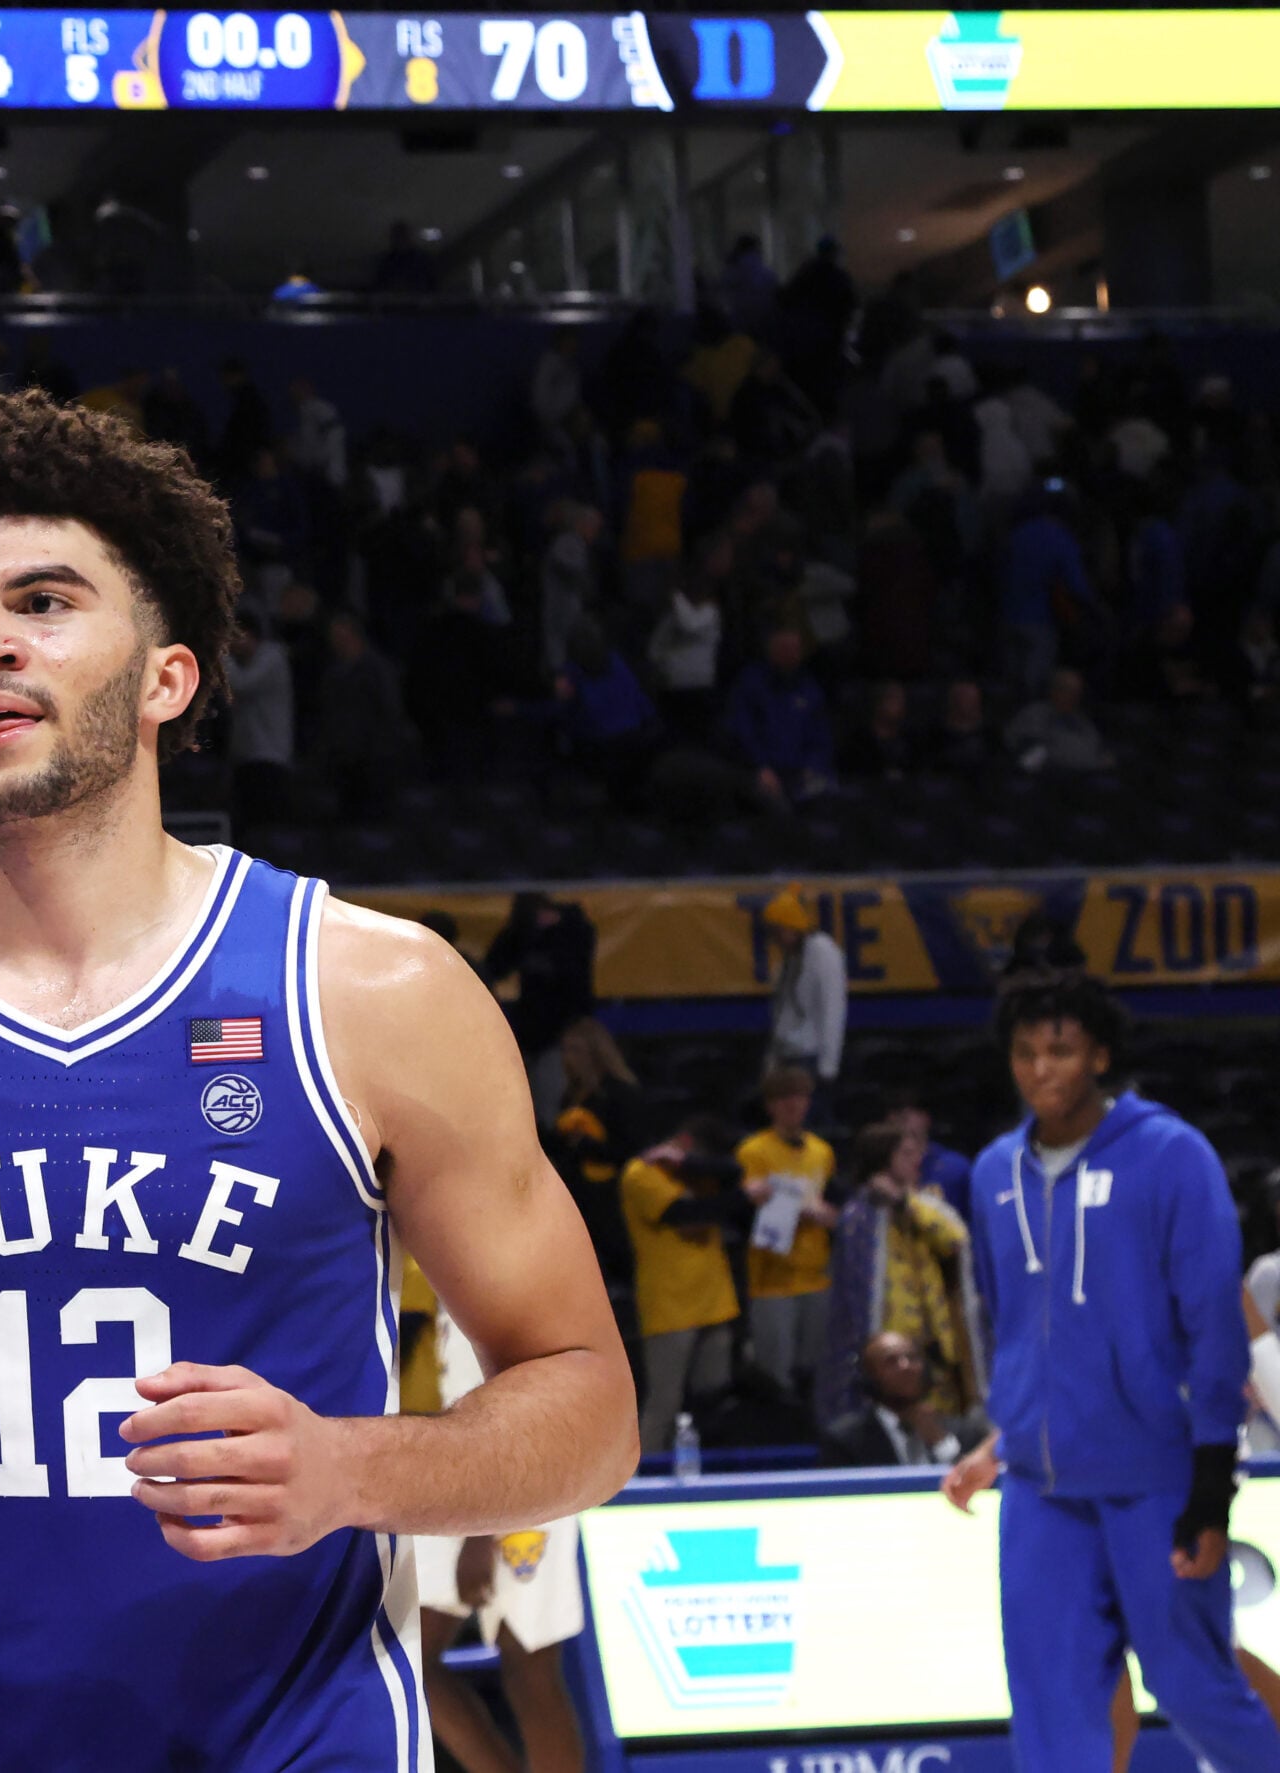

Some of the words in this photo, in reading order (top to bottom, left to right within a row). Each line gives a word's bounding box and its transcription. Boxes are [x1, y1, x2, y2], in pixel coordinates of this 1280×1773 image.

[61, 17, 110, 56] FLS
[186, 12, 312, 69] 00.0
[396, 19, 443, 57] FLS
[65, 54, 100, 103] 5
[405, 57, 439, 104] 8
[479, 20, 588, 101] 70
[737, 890, 884, 985] TE
[1107, 883, 1258, 974] ZOO
[211, 1094, 257, 1107] ACC
[668, 1612, 792, 1637] LOTTERY
